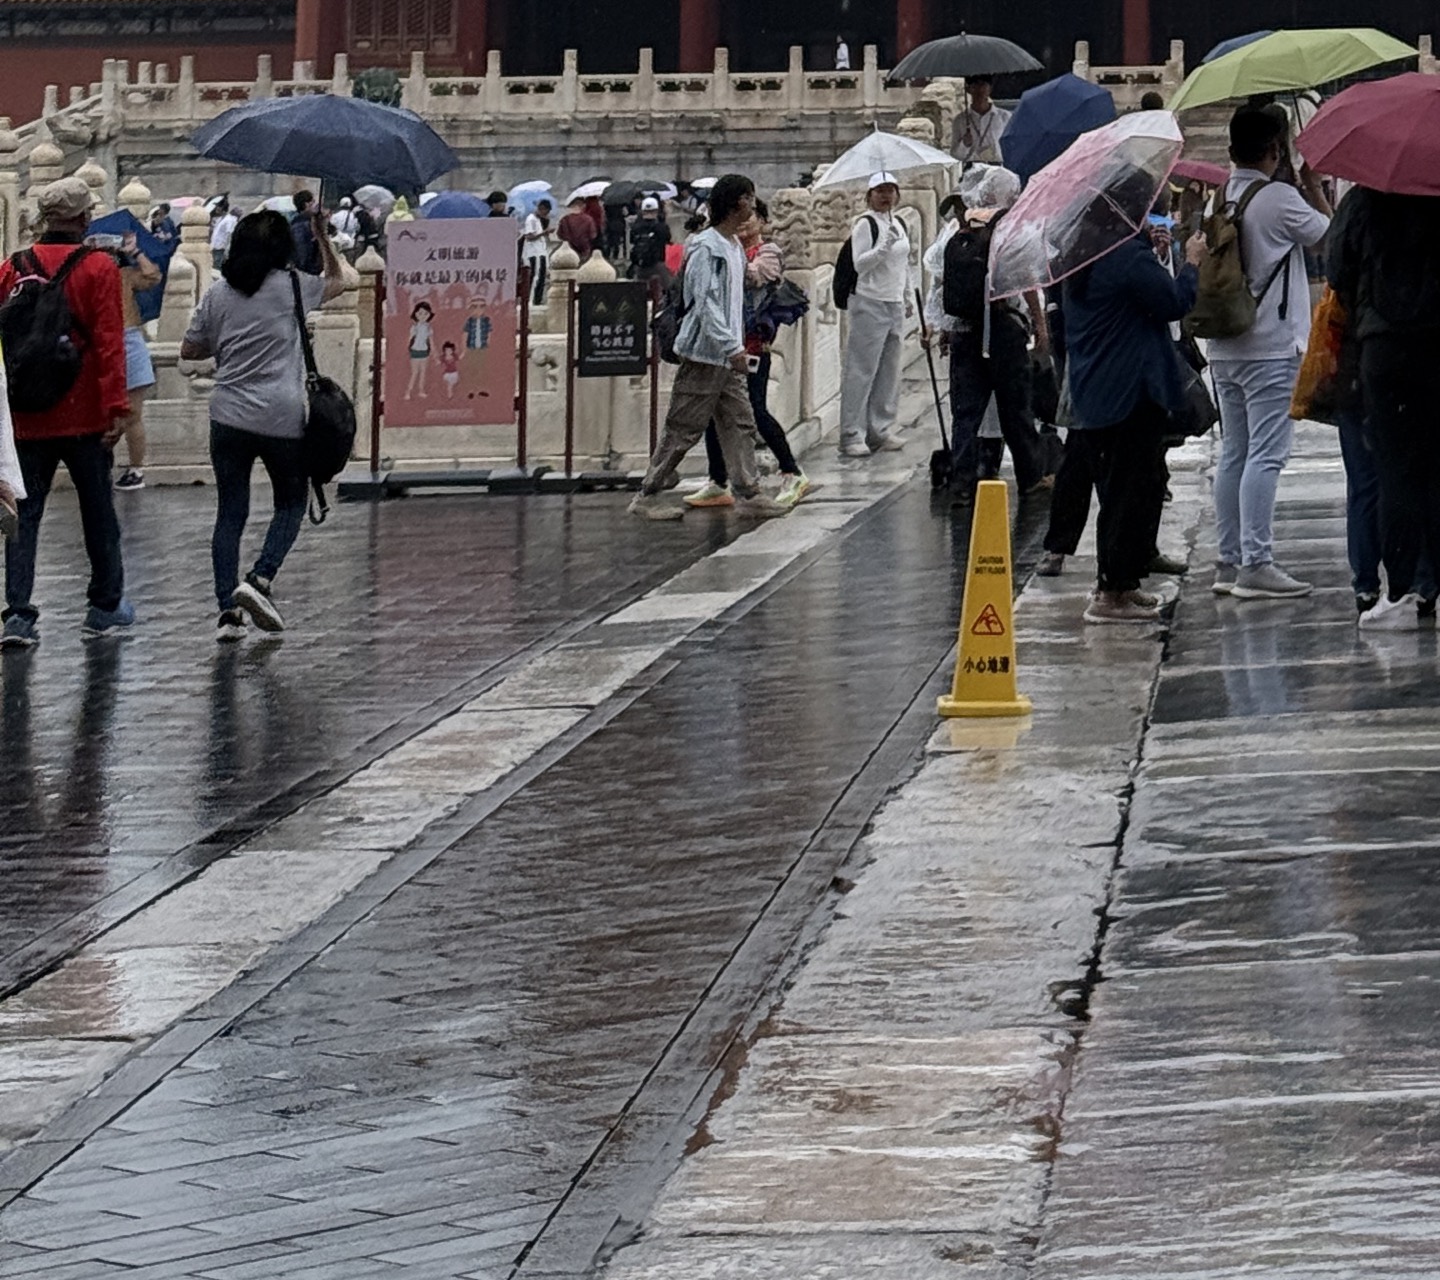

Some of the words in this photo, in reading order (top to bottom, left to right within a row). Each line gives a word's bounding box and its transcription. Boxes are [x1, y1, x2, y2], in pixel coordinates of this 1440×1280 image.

[425, 246, 479, 262] 文明旅游
[396, 268, 508, 286] 你就是最美的风景
[977, 555, 1004, 565] CAUTION
[963, 655, 1010, 674] 小心地滑
